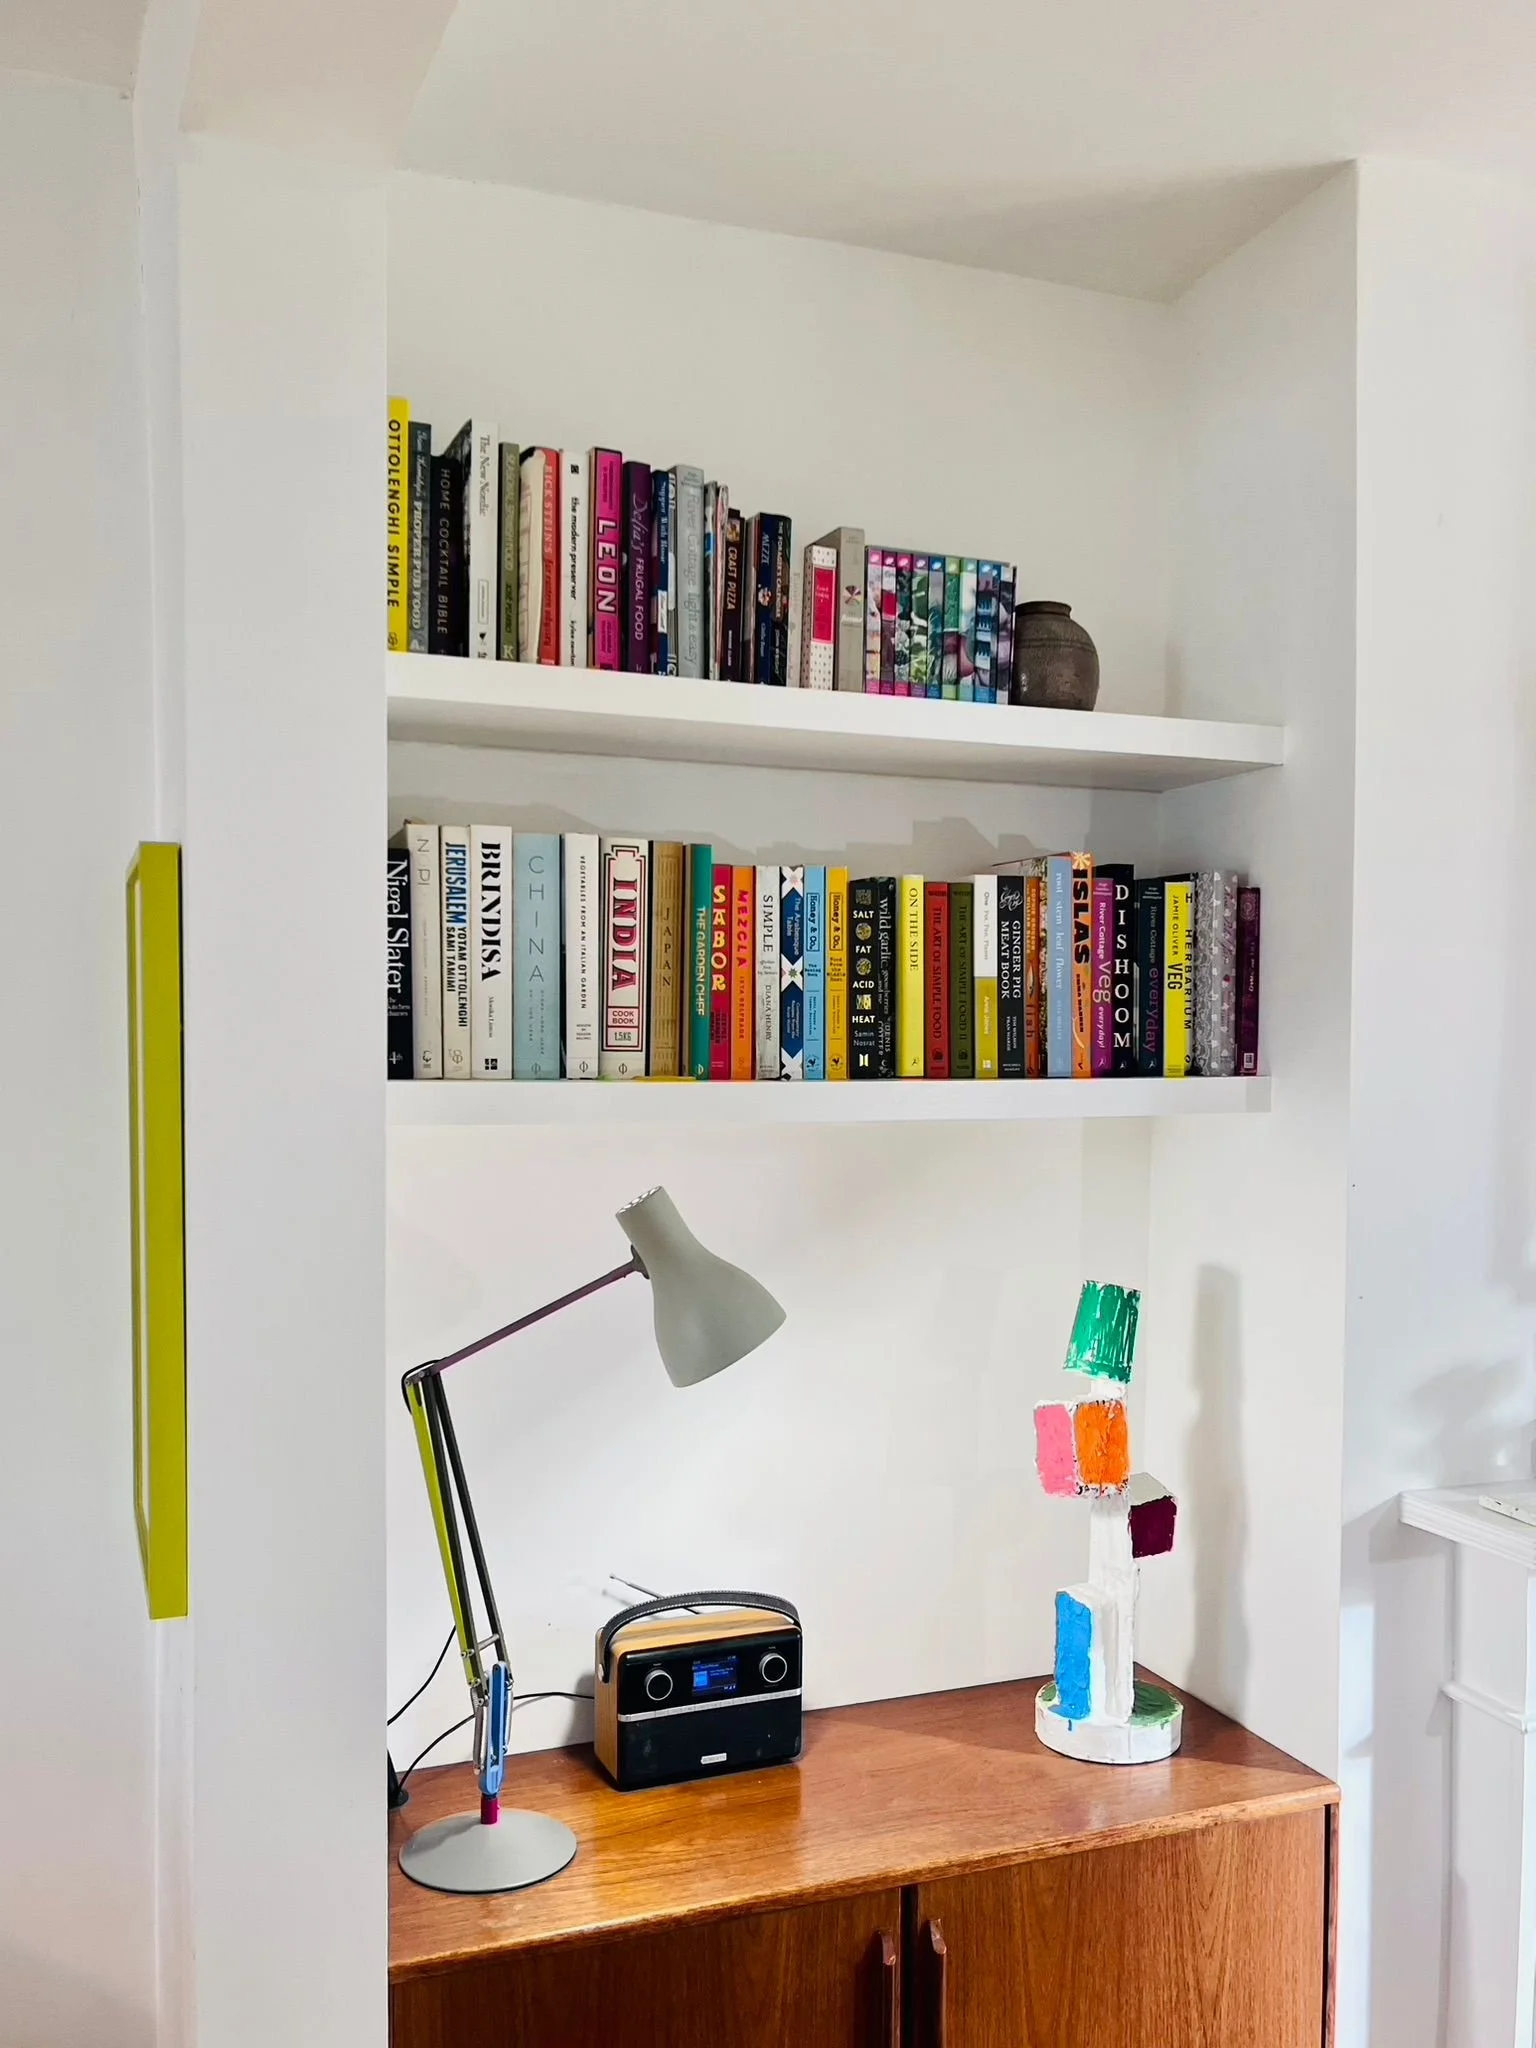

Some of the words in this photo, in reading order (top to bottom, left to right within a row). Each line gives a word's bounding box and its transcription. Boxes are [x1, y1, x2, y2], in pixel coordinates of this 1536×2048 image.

[480, 434, 491, 453] The
[388, 418, 401, 535] OTTOLENGHI
[479, 456, 490, 478] New
[544, 465, 553, 497] RICK
[439, 467, 450, 509] HOME
[479, 480, 490, 517] Nordic
[570, 496, 580, 513] the
[570, 514, 581, 552] modern
[631, 492, 650, 555] Delia's
[438, 517, 450, 587] COCKTAIL
[597, 518, 617, 613] LEON
[727, 546, 738, 578] CRAFT
[761, 531, 771, 566] MEZZE
[387, 543, 401, 608] SIMPLE
[411, 558, 422, 592] PUB
[568, 553, 578, 601] preserver
[634, 557, 645, 602] FRUGAL
[411, 591, 422, 629] FOOD
[726, 581, 737, 610] PIZZA
[775, 578, 783, 618] CALENDAR
[436, 594, 448, 635] BIBLE
[634, 604, 645, 641] FOOD
[388, 858, 409, 920] Nigel
[444, 842, 467, 924] JERUSALEM
[909, 888, 919, 907] ON
[1055, 872, 1065, 894] root
[481, 841, 502, 982] BRINDISA
[529, 855, 545, 983] CHINA
[695, 905, 706, 930] THE
[794, 897, 802, 912] The
[807, 894, 818, 924] Honey
[832, 894, 842, 923] Honey
[852, 910, 875, 919] SALT
[878, 896, 892, 930] wild
[933, 905, 943, 924] THE
[959, 904, 968, 921] THE
[1055, 899, 1065, 925] stem
[1072, 868, 1090, 965] ISLAS
[1098, 901, 1107, 924] River
[1149, 905, 1158, 929] River
[1172, 895, 1180, 921] JAMIE
[446, 925, 456, 952] SAMI
[581, 930, 587, 942] AN
[611, 877, 638, 991] INDIA
[711, 884, 728, 992] SABOR
[736, 889, 749, 967] MEZCLA
[762, 894, 774, 953] SIMPLE
[786, 916, 795, 937] Table
[793, 911, 802, 956] Arabesque
[808, 926, 818, 934] &
[909, 910, 919, 938] THE
[933, 926, 943, 949] ART
[959, 924, 968, 945] ART
[1001, 920, 1010, 958] MEAT
[1172, 923, 1180, 957] OLIVER
[457, 926, 467, 962] YOTAM
[664, 907, 672, 987] JAPAN
[695, 930, 706, 981] GARDEN
[808, 935, 818, 950] Co.
[833, 934, 842, 949] Co.
[855, 945, 872, 954] FAT
[878, 931, 892, 969] garlic
[909, 940, 919, 972] SIDE
[1012, 920, 1022, 973] GINGER
[1055, 932, 1066, 953] leaf
[1097, 925, 1107, 961] Cottage
[1148, 929, 1158, 964] Cottage
[388, 927, 410, 994] Slater
[446, 955, 457, 993] TAMIMI
[959, 960, 968, 995] SIMPLE
[1054, 957, 1066, 990] flower
[1113, 884, 1131, 1048] DISHOOM
[1167, 963, 1183, 990] VEG
[457, 963, 469, 1027] OTTOLENGHI
[852, 980, 875, 989] ACID
[932, 965, 942, 1003] SIMPLE
[1001, 961, 1010, 999] BOOK
[1012, 976, 1022, 999] PIG
[1092, 960, 1113, 1005] veg
[1184, 928, 1194, 1030] HERBARIUM
[695, 983, 705, 1016] CHEF
[764, 984, 773, 1011] DIANA
[1142, 967, 1160, 1052] everyday
[763, 1013, 773, 1041] HENRY
[852, 1015, 876, 1024] HEAT
[932, 1006, 942, 1039] FOOD
[959, 999, 968, 1031] FOOD
[614, 1032, 632, 1041] 1.5KG
[853, 1039, 876, 1048] Nosrat
[854, 1030, 875, 1038] Samin
[883, 1021, 891, 1052] DENIS
